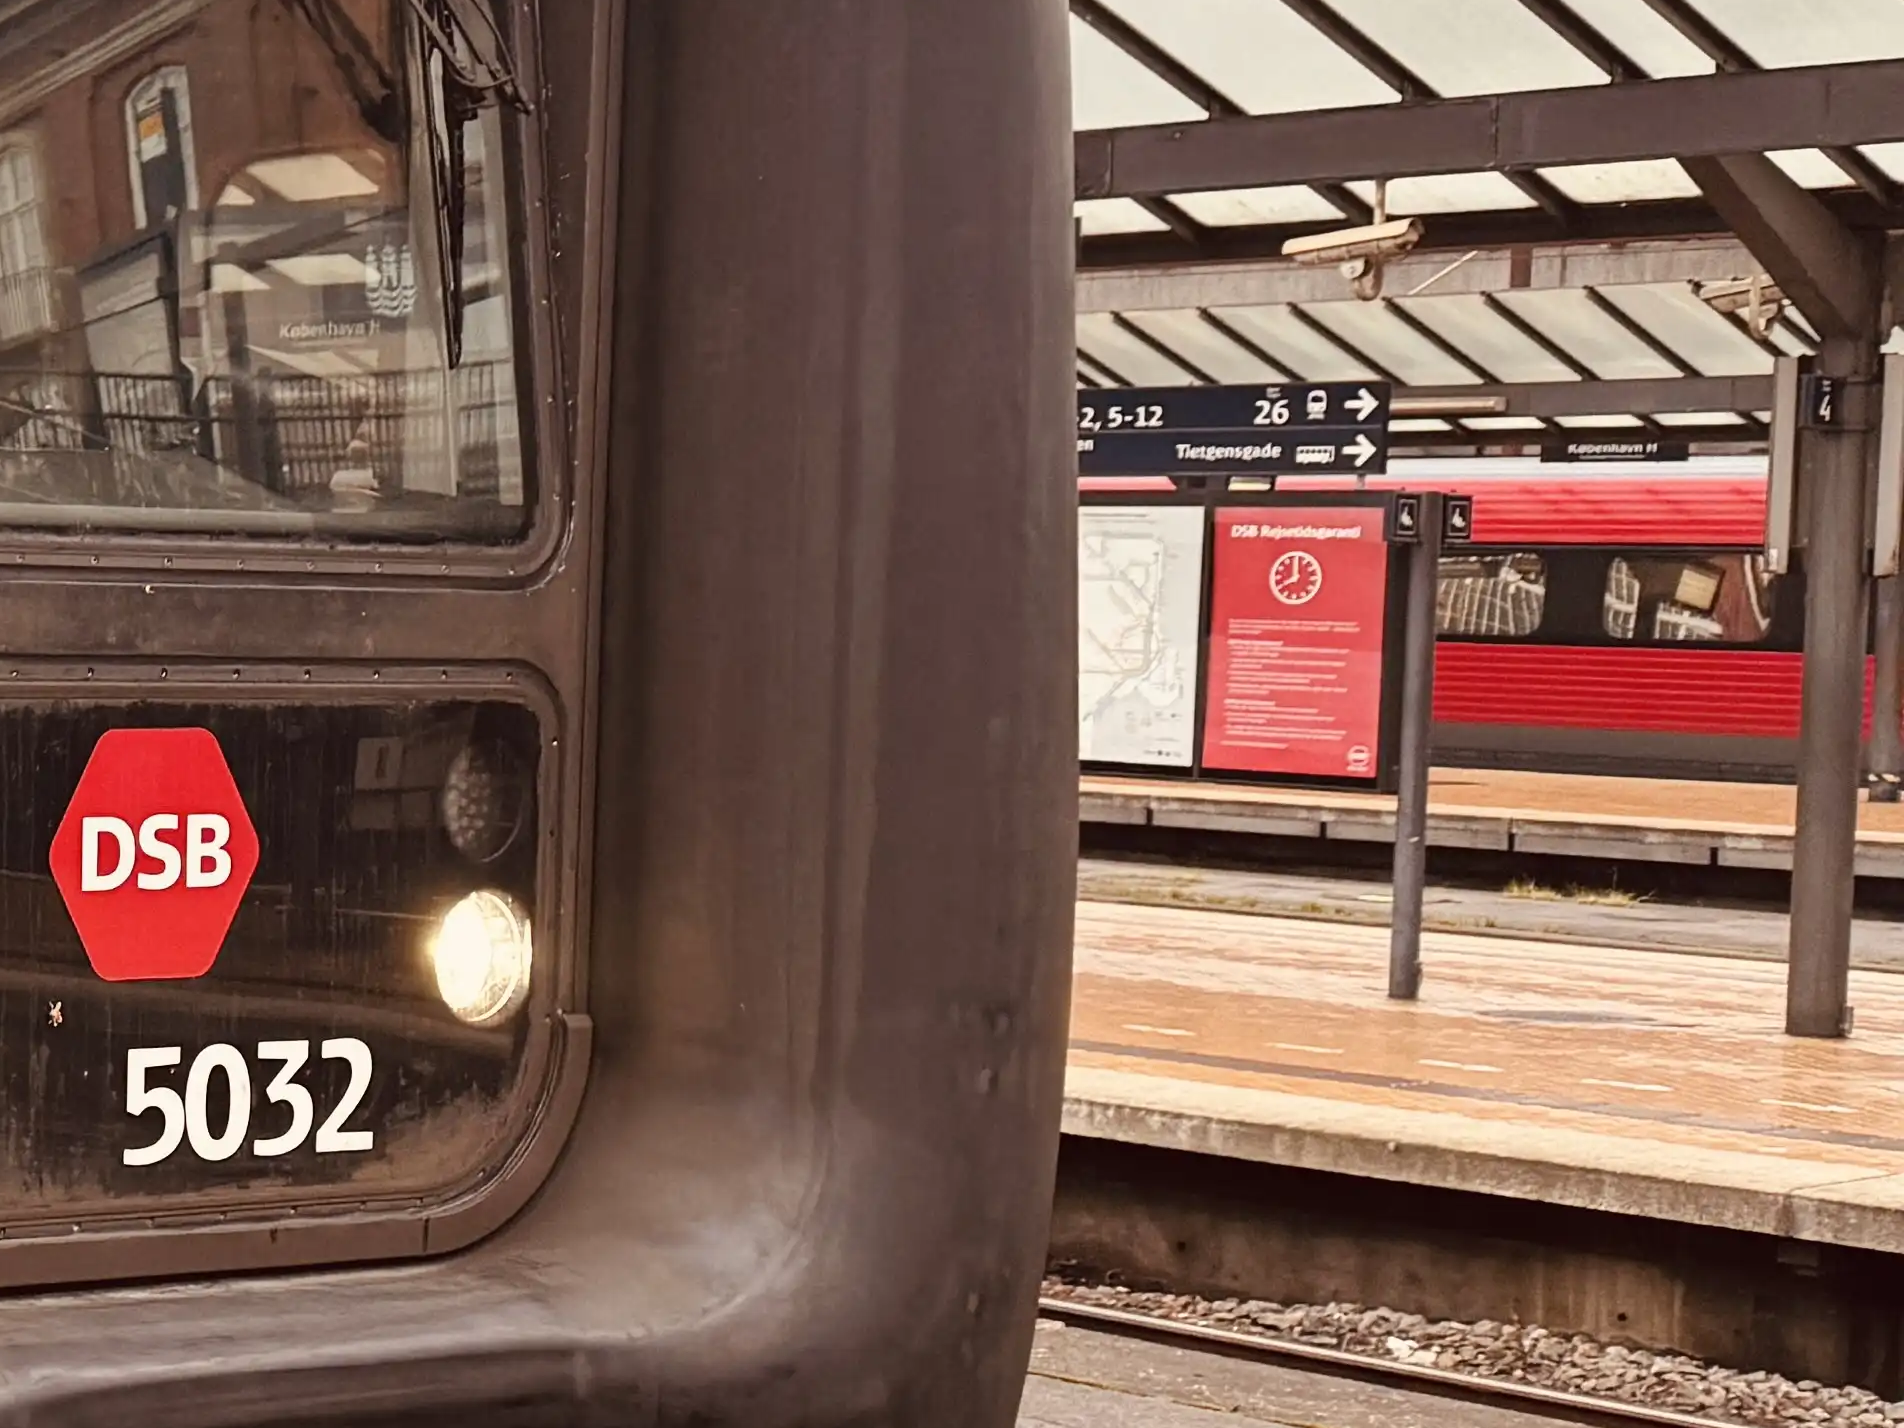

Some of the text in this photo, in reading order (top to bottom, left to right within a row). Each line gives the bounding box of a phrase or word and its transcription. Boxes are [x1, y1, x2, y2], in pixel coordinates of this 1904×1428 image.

[1107, 405, 1164, 429] 5-12
[1253, 399, 1290, 425] 26
[1819, 394, 1832, 422] 4
[1175, 442, 1282, 462] Tietgensgade
[1231, 524, 1258, 538] DSB
[80, 813, 232, 892] DSB
[122, 1037, 375, 1166] 5032
